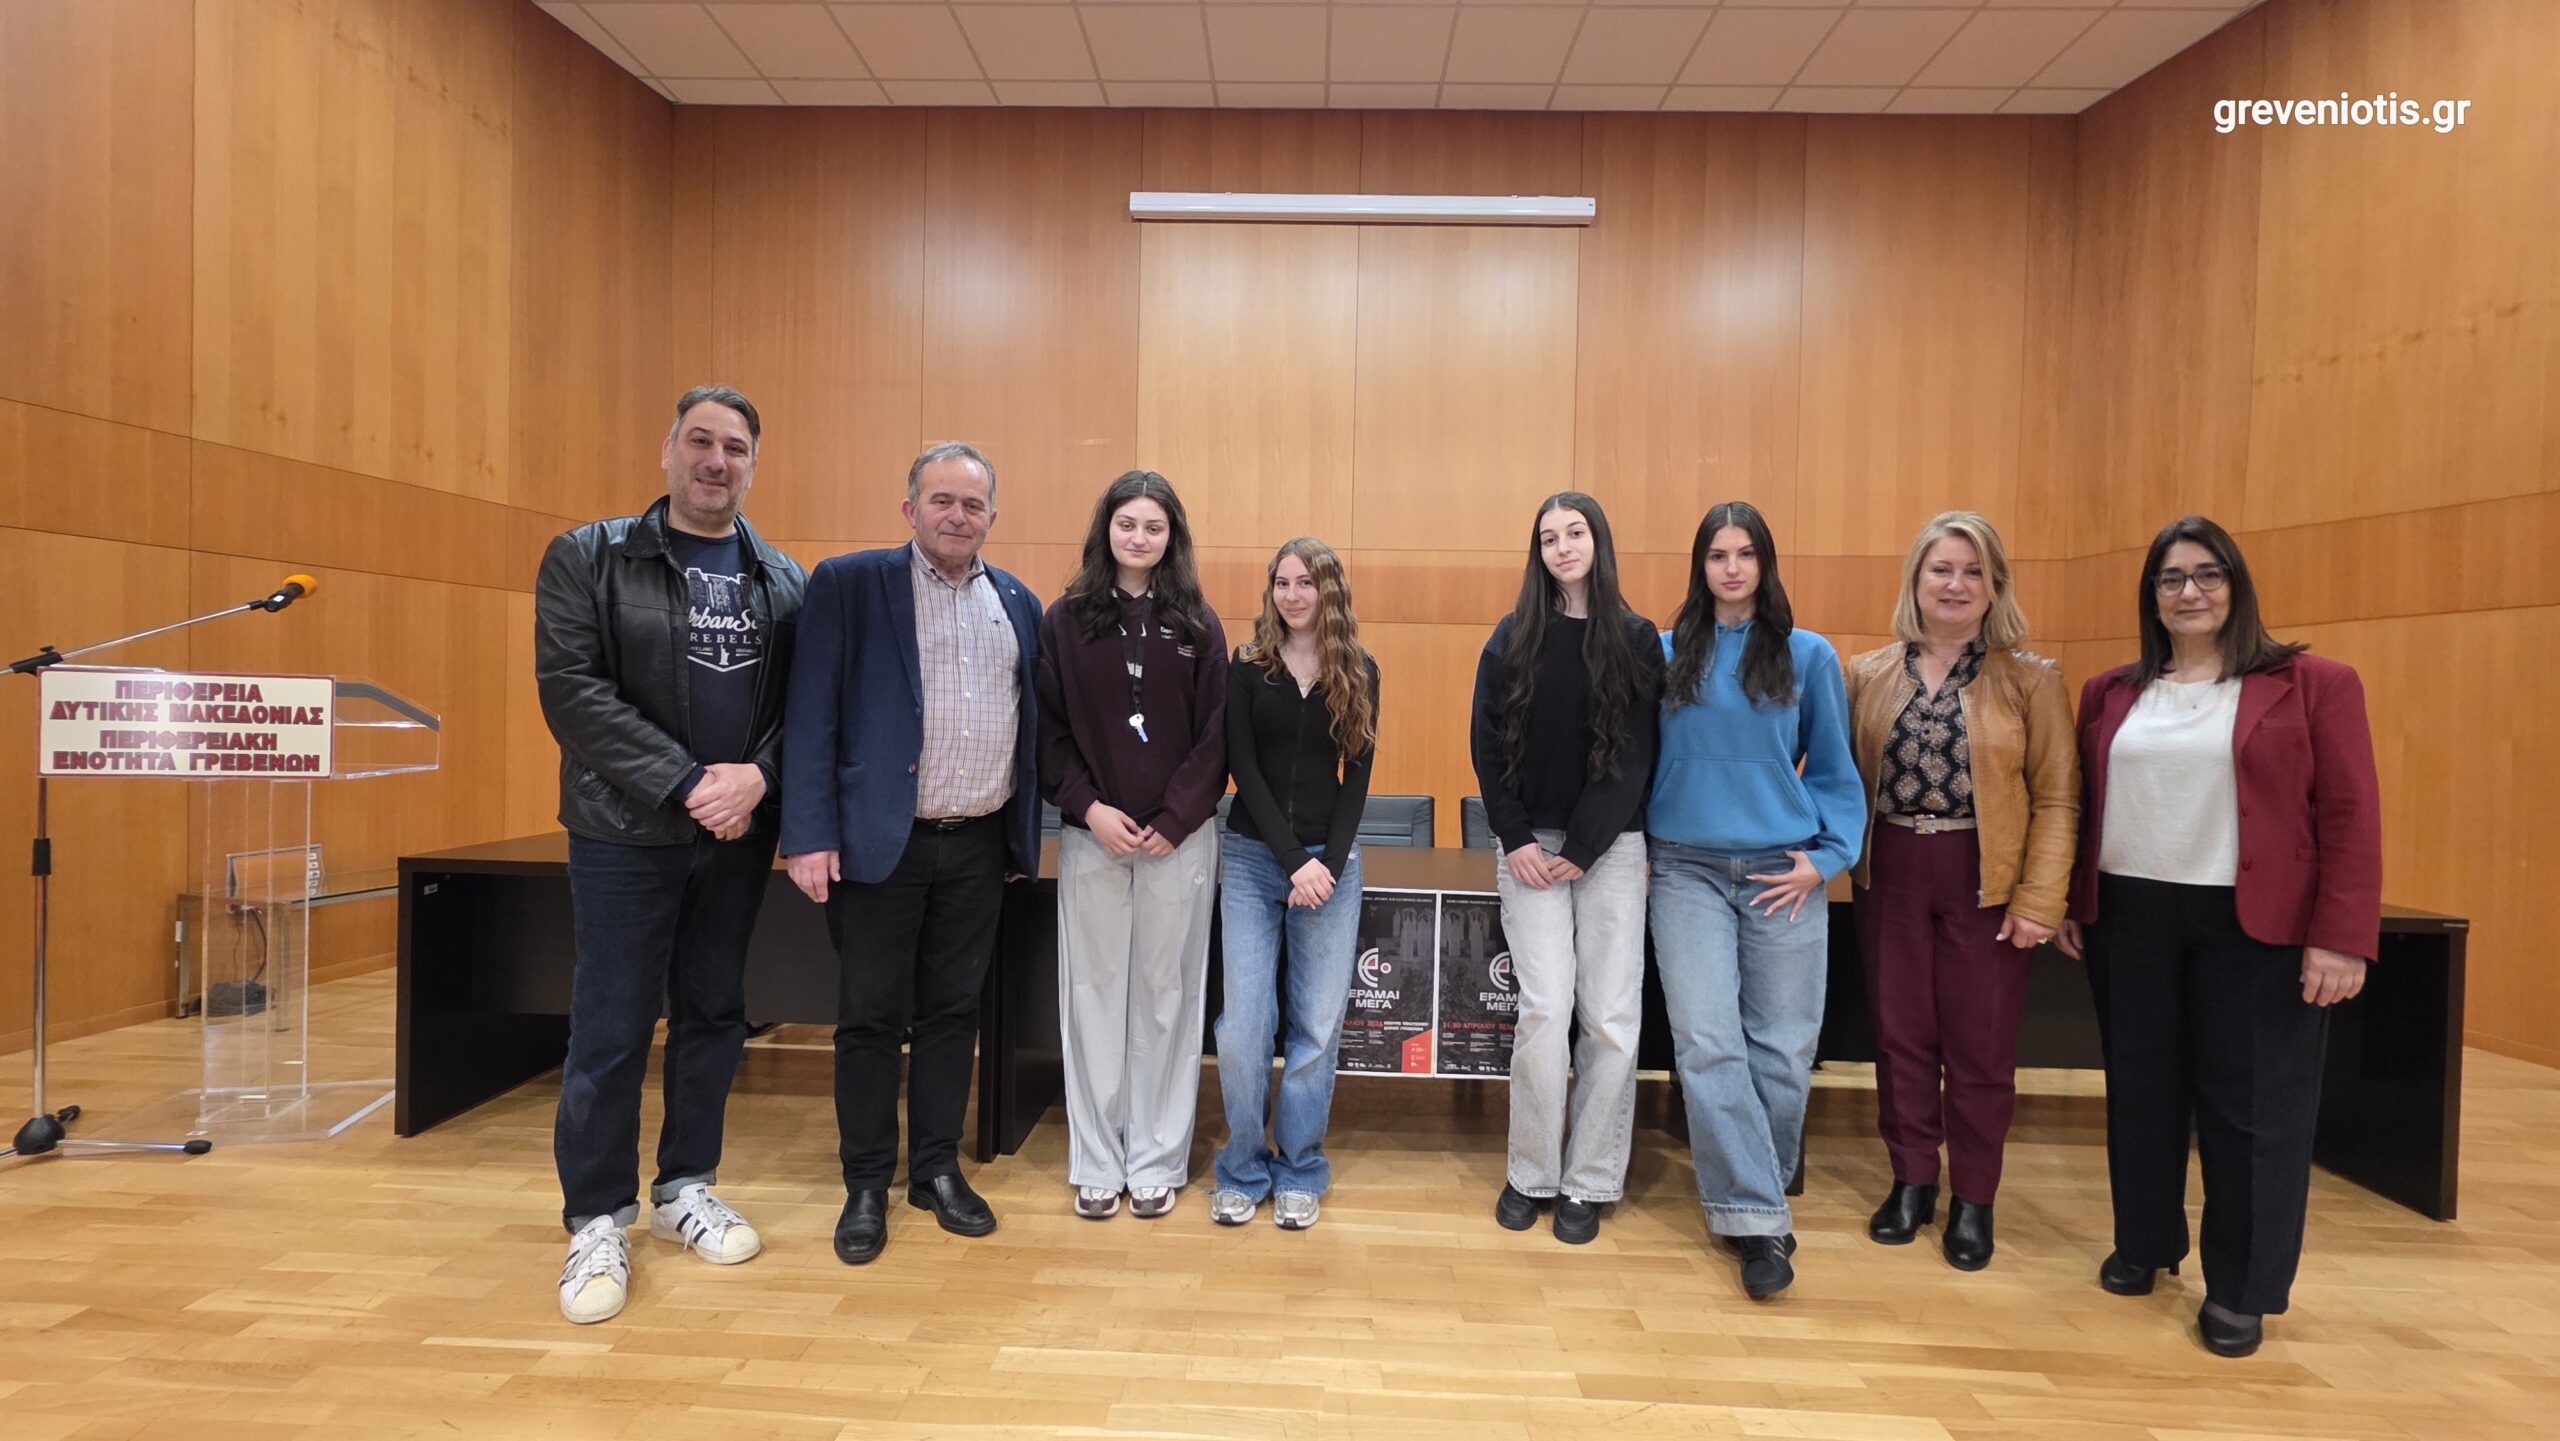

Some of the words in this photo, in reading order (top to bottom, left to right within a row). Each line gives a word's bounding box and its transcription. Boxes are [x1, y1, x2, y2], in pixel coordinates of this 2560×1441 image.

[689, 632, 762, 645] REBELS
[115, 680, 263, 702] ΠΕΡΙΦΕΡΕΙΑ
[49, 701, 158, 721] ΔΥΤΙΚΗΣ
[169, 703, 324, 725] ΜΑΚΕΔΟΝΙΑΣ
[100, 730, 277, 750] ΠΕΡΙΦΕΡΕΙΑΚΗ
[53, 751, 176, 770] ΕΝΟΤΗΤΑ
[189, 753, 320, 772] ΓΡΕΒΕΝΩΝ
[1348, 989, 1400, 1000] ΕΡΑΜΑΙ
[1479, 992, 1518, 1002] ΕΡΑΜ
[1355, 998, 1392, 1009] ΜΕΓΑ
